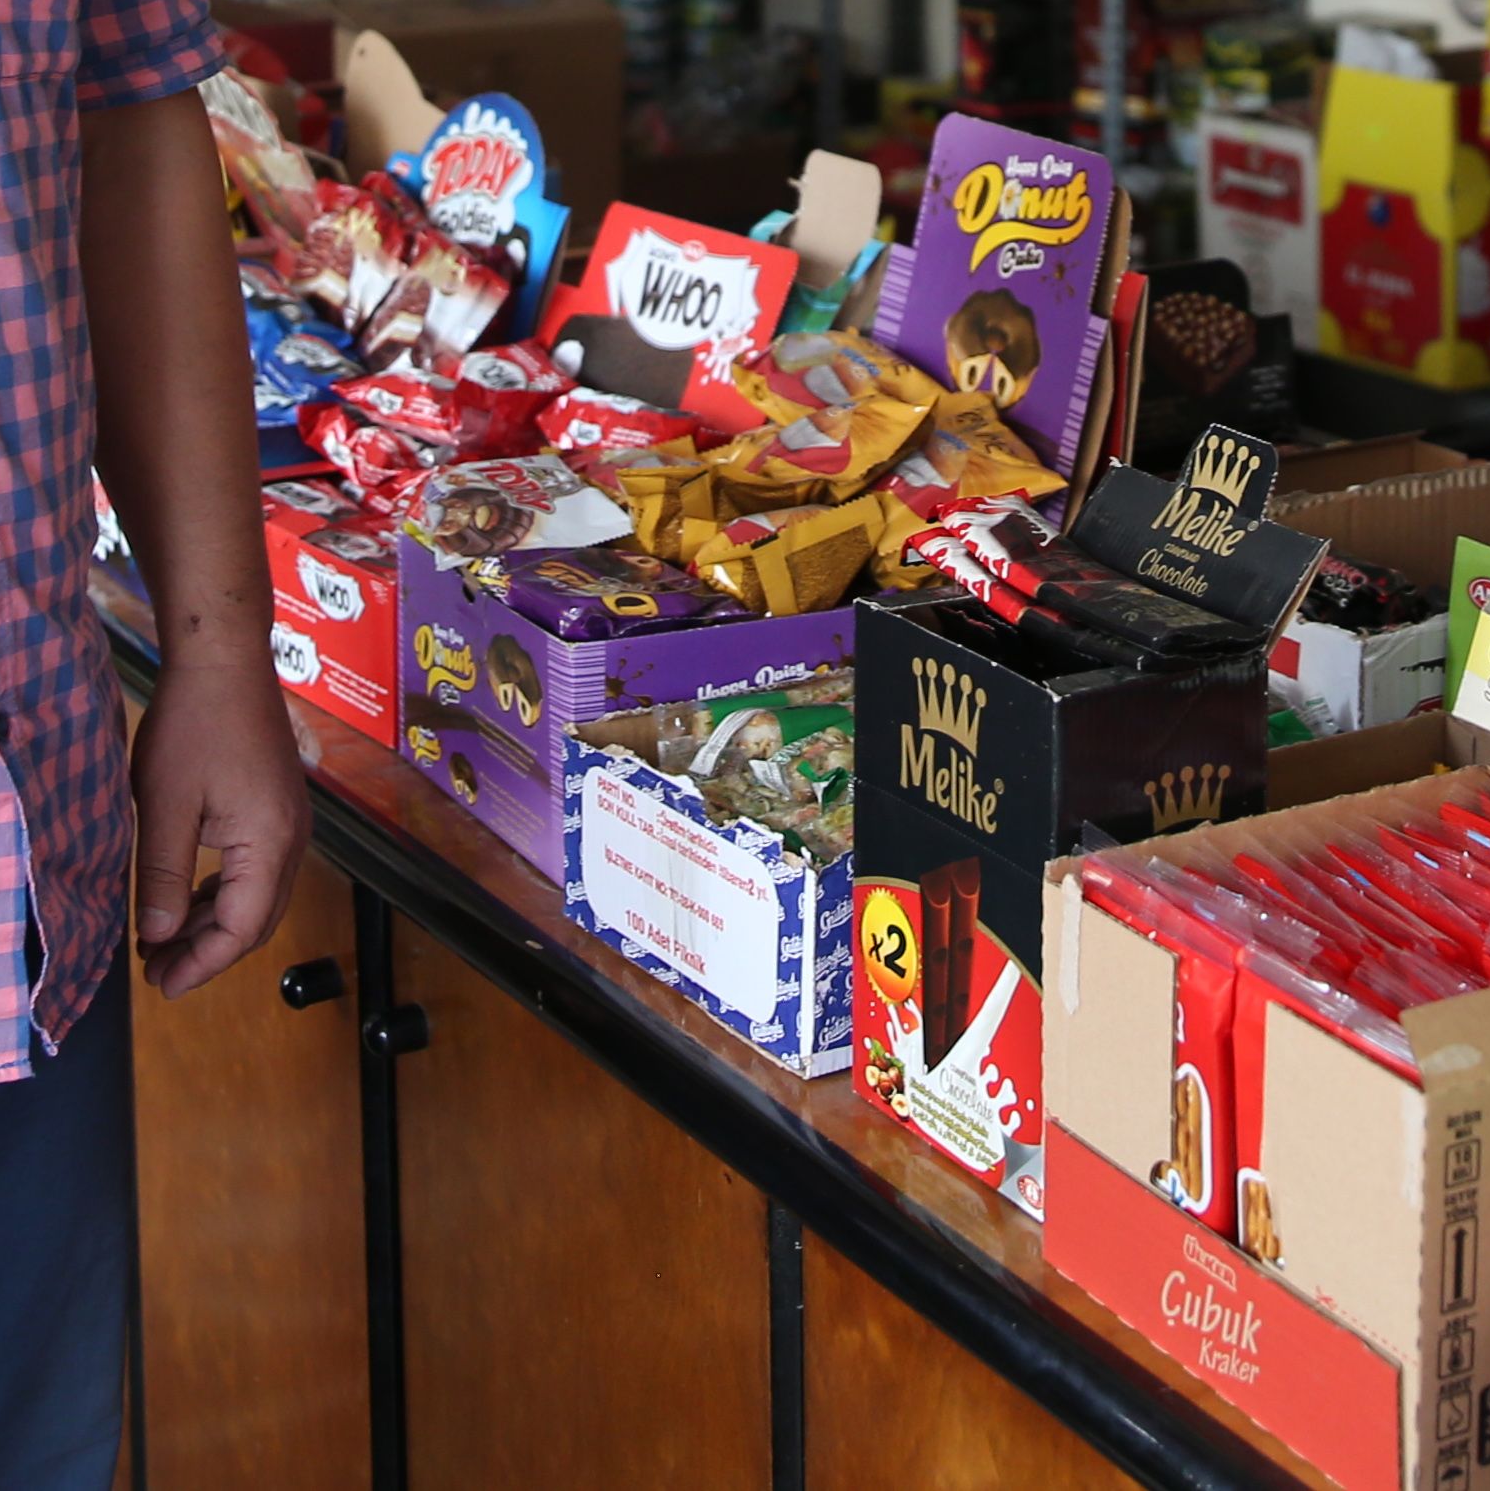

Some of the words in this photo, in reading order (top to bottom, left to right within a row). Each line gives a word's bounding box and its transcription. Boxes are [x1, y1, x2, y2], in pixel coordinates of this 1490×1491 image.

[429, 136, 523, 206] TODAY
[436, 206, 497, 237] Goldies
[953, 162, 1092, 248] Donut
[998, 242, 1044, 278] Cake
[638, 261, 722, 329] WHOO
[1151, 486, 1246, 557] Melike
[1137, 548, 1208, 598] Chocolate
[754, 662, 814, 686] Daisy
[899, 724, 998, 834] Melike
[625, 909, 646, 936] 100
[647, 922, 671, 953] Adet
[673, 940, 707, 975] Piknik
[1161, 1270, 1262, 1354] Çubuk
[1199, 1337, 1260, 1385] Kraker
